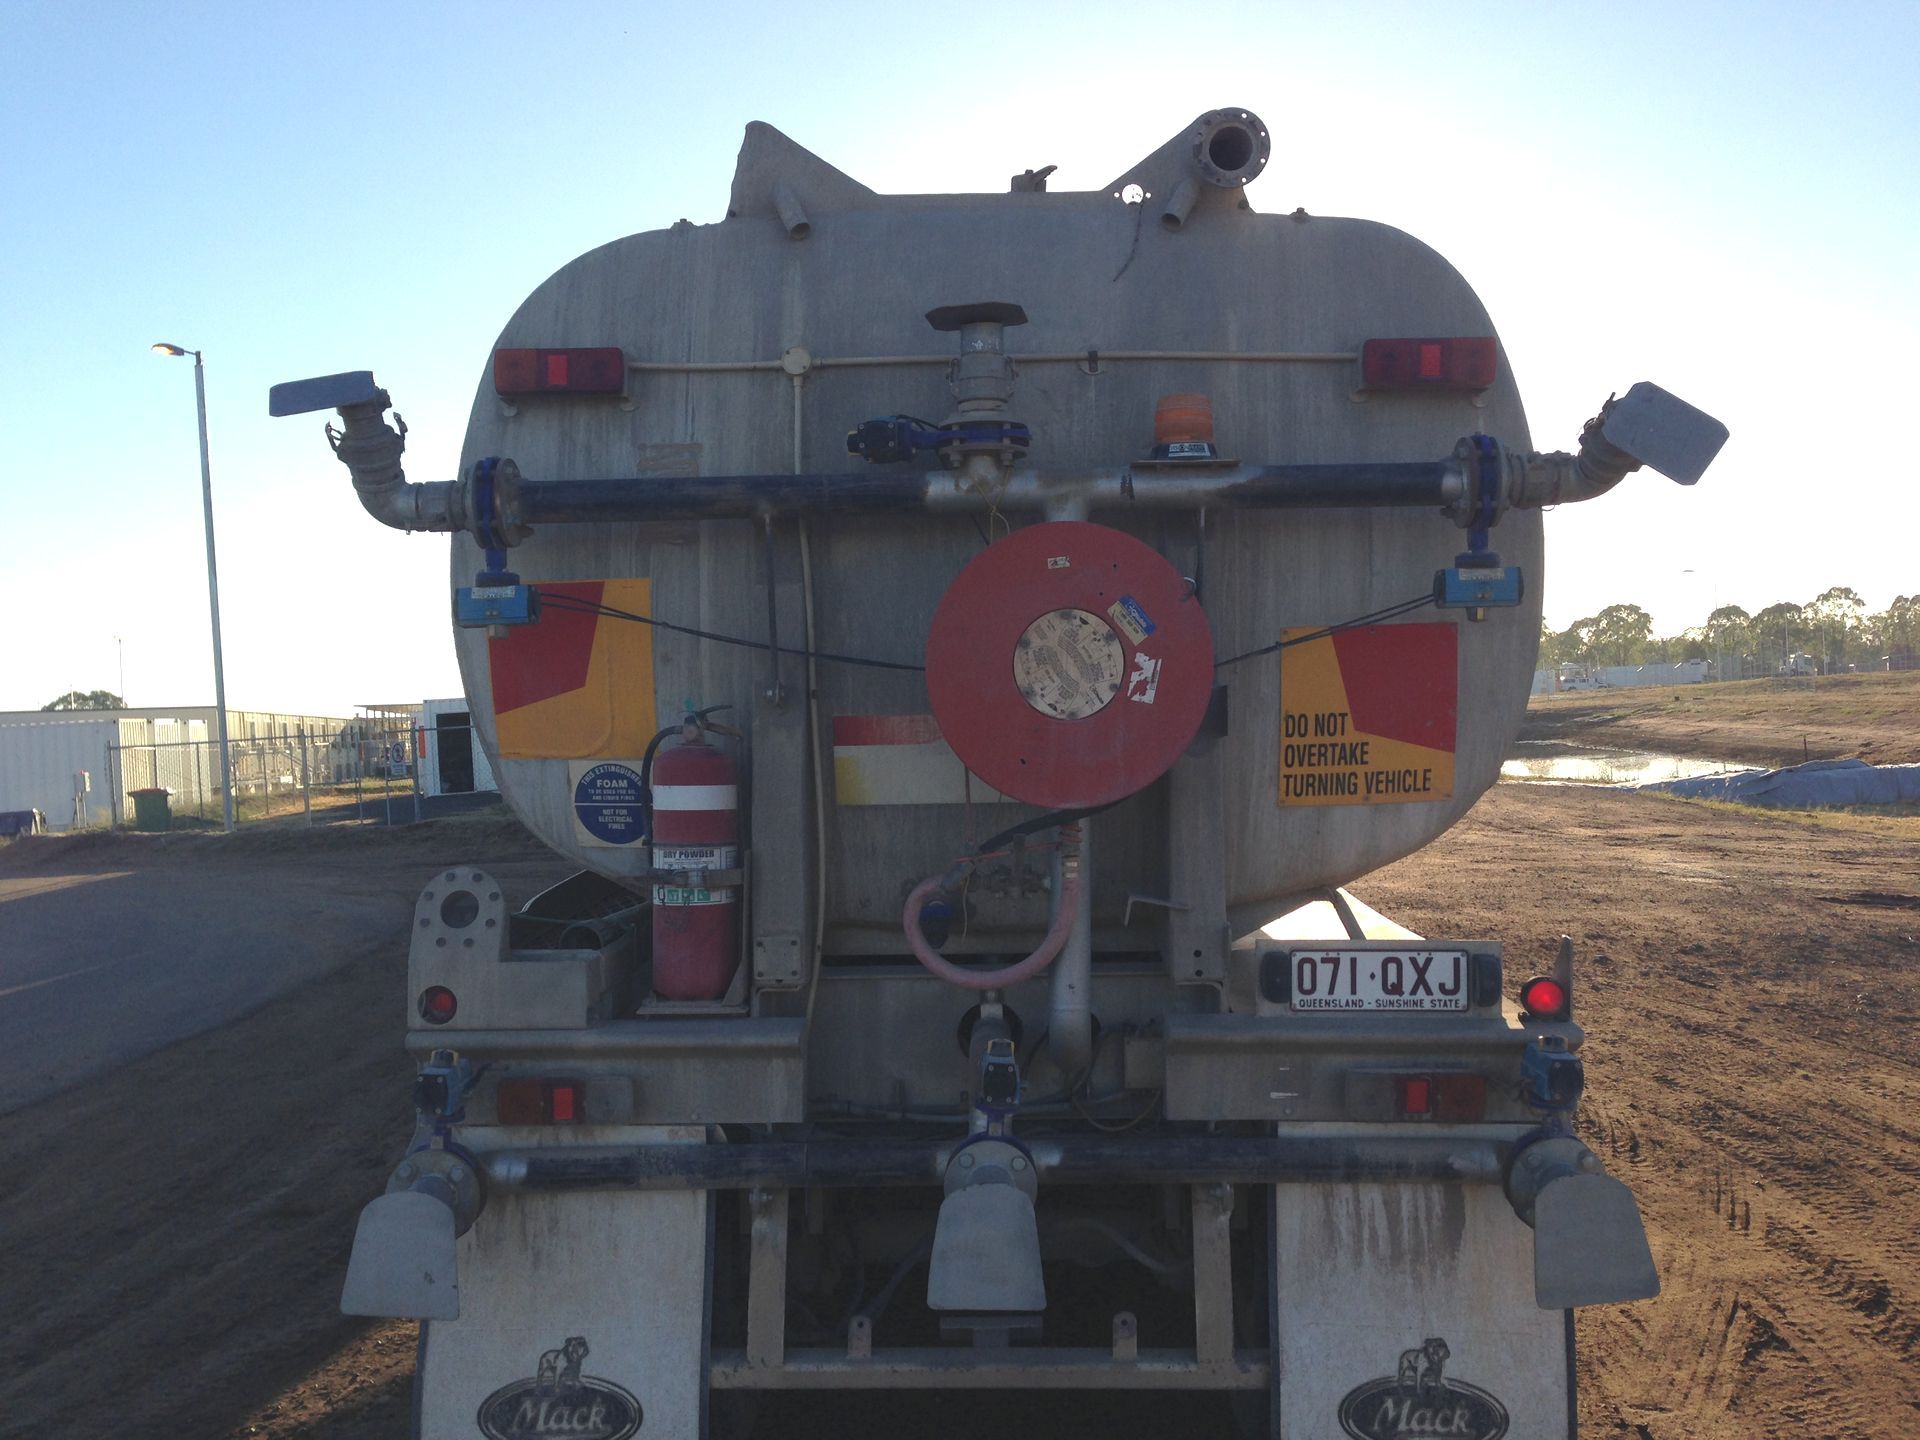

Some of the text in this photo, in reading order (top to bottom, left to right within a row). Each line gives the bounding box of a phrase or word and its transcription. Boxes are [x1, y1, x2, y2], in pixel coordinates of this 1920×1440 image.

[1285, 712, 1349, 738] DO NOT
[1284, 741, 1370, 768] OVERTAKE
[581, 770, 595, 785] THIS
[596, 779, 628, 788] FOAM
[1283, 768, 1432, 797] TURNING VEHICLE
[598, 815, 633, 823] ELECTRICAL
[602, 808, 628, 816] NOT FOR
[663, 849, 715, 858] DRY POWDER
[1298, 999, 1365, 1008] QUEENSLAND
[1375, 998, 1425, 1008] SUNSHINE
[1430, 998, 1460, 1008] STATE
[511, 1398, 609, 1432] Mack
[1374, 1398, 1471, 1433] Mack
